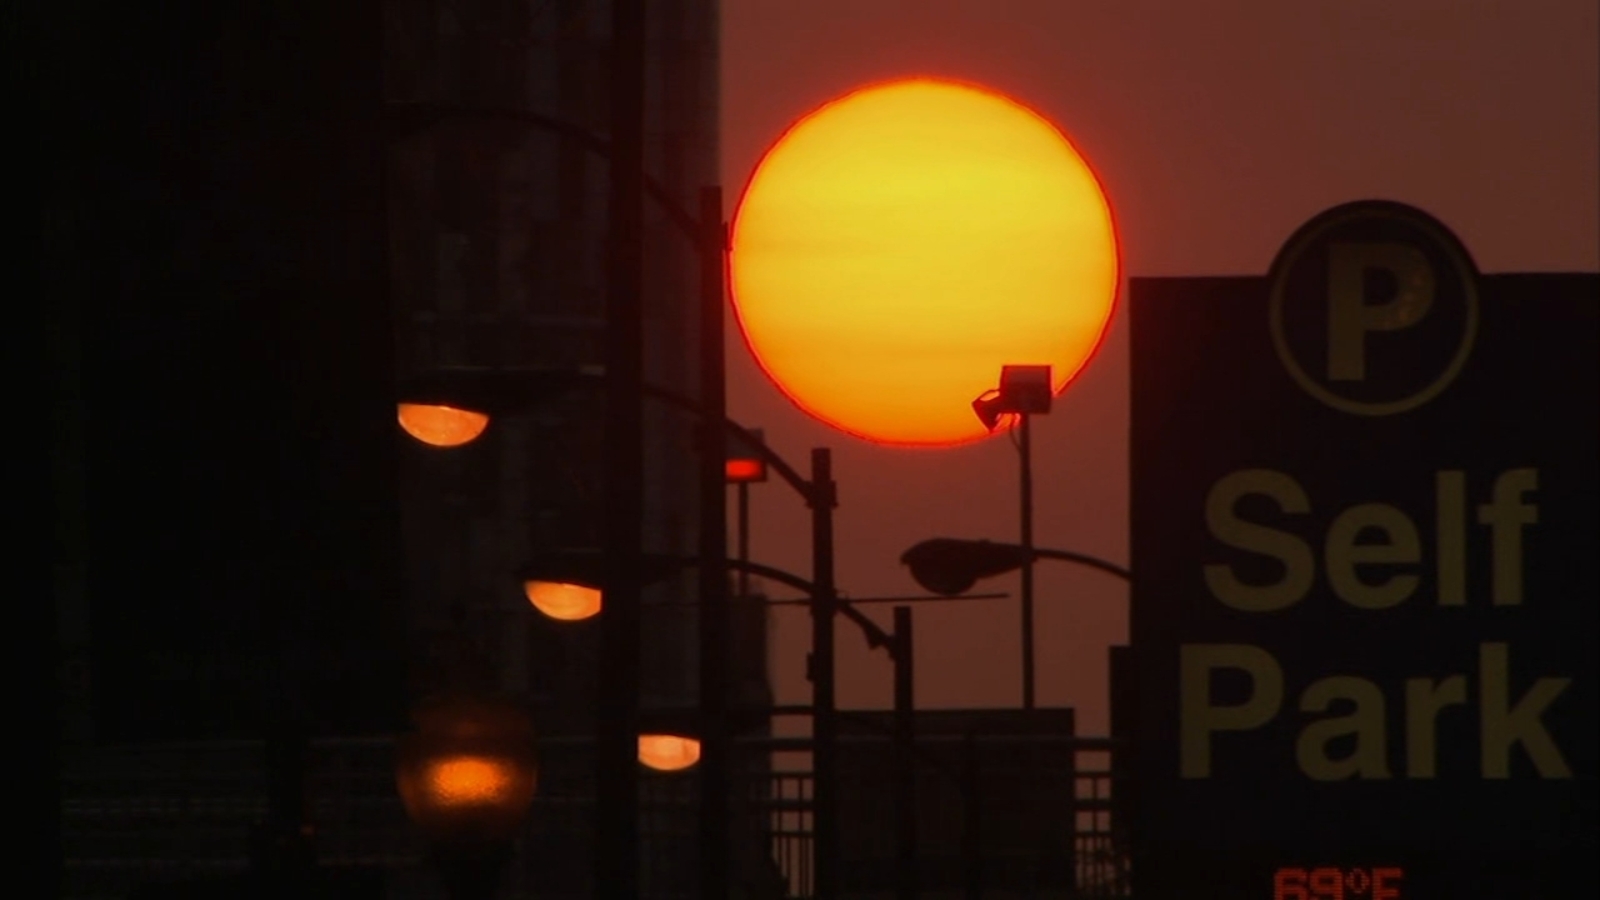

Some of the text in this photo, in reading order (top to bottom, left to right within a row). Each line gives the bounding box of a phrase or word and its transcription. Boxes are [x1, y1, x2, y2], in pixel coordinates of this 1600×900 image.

[1326, 242, 1436, 381] P
[1203, 468, 1539, 613] Self
[1177, 641, 1573, 781] Park
